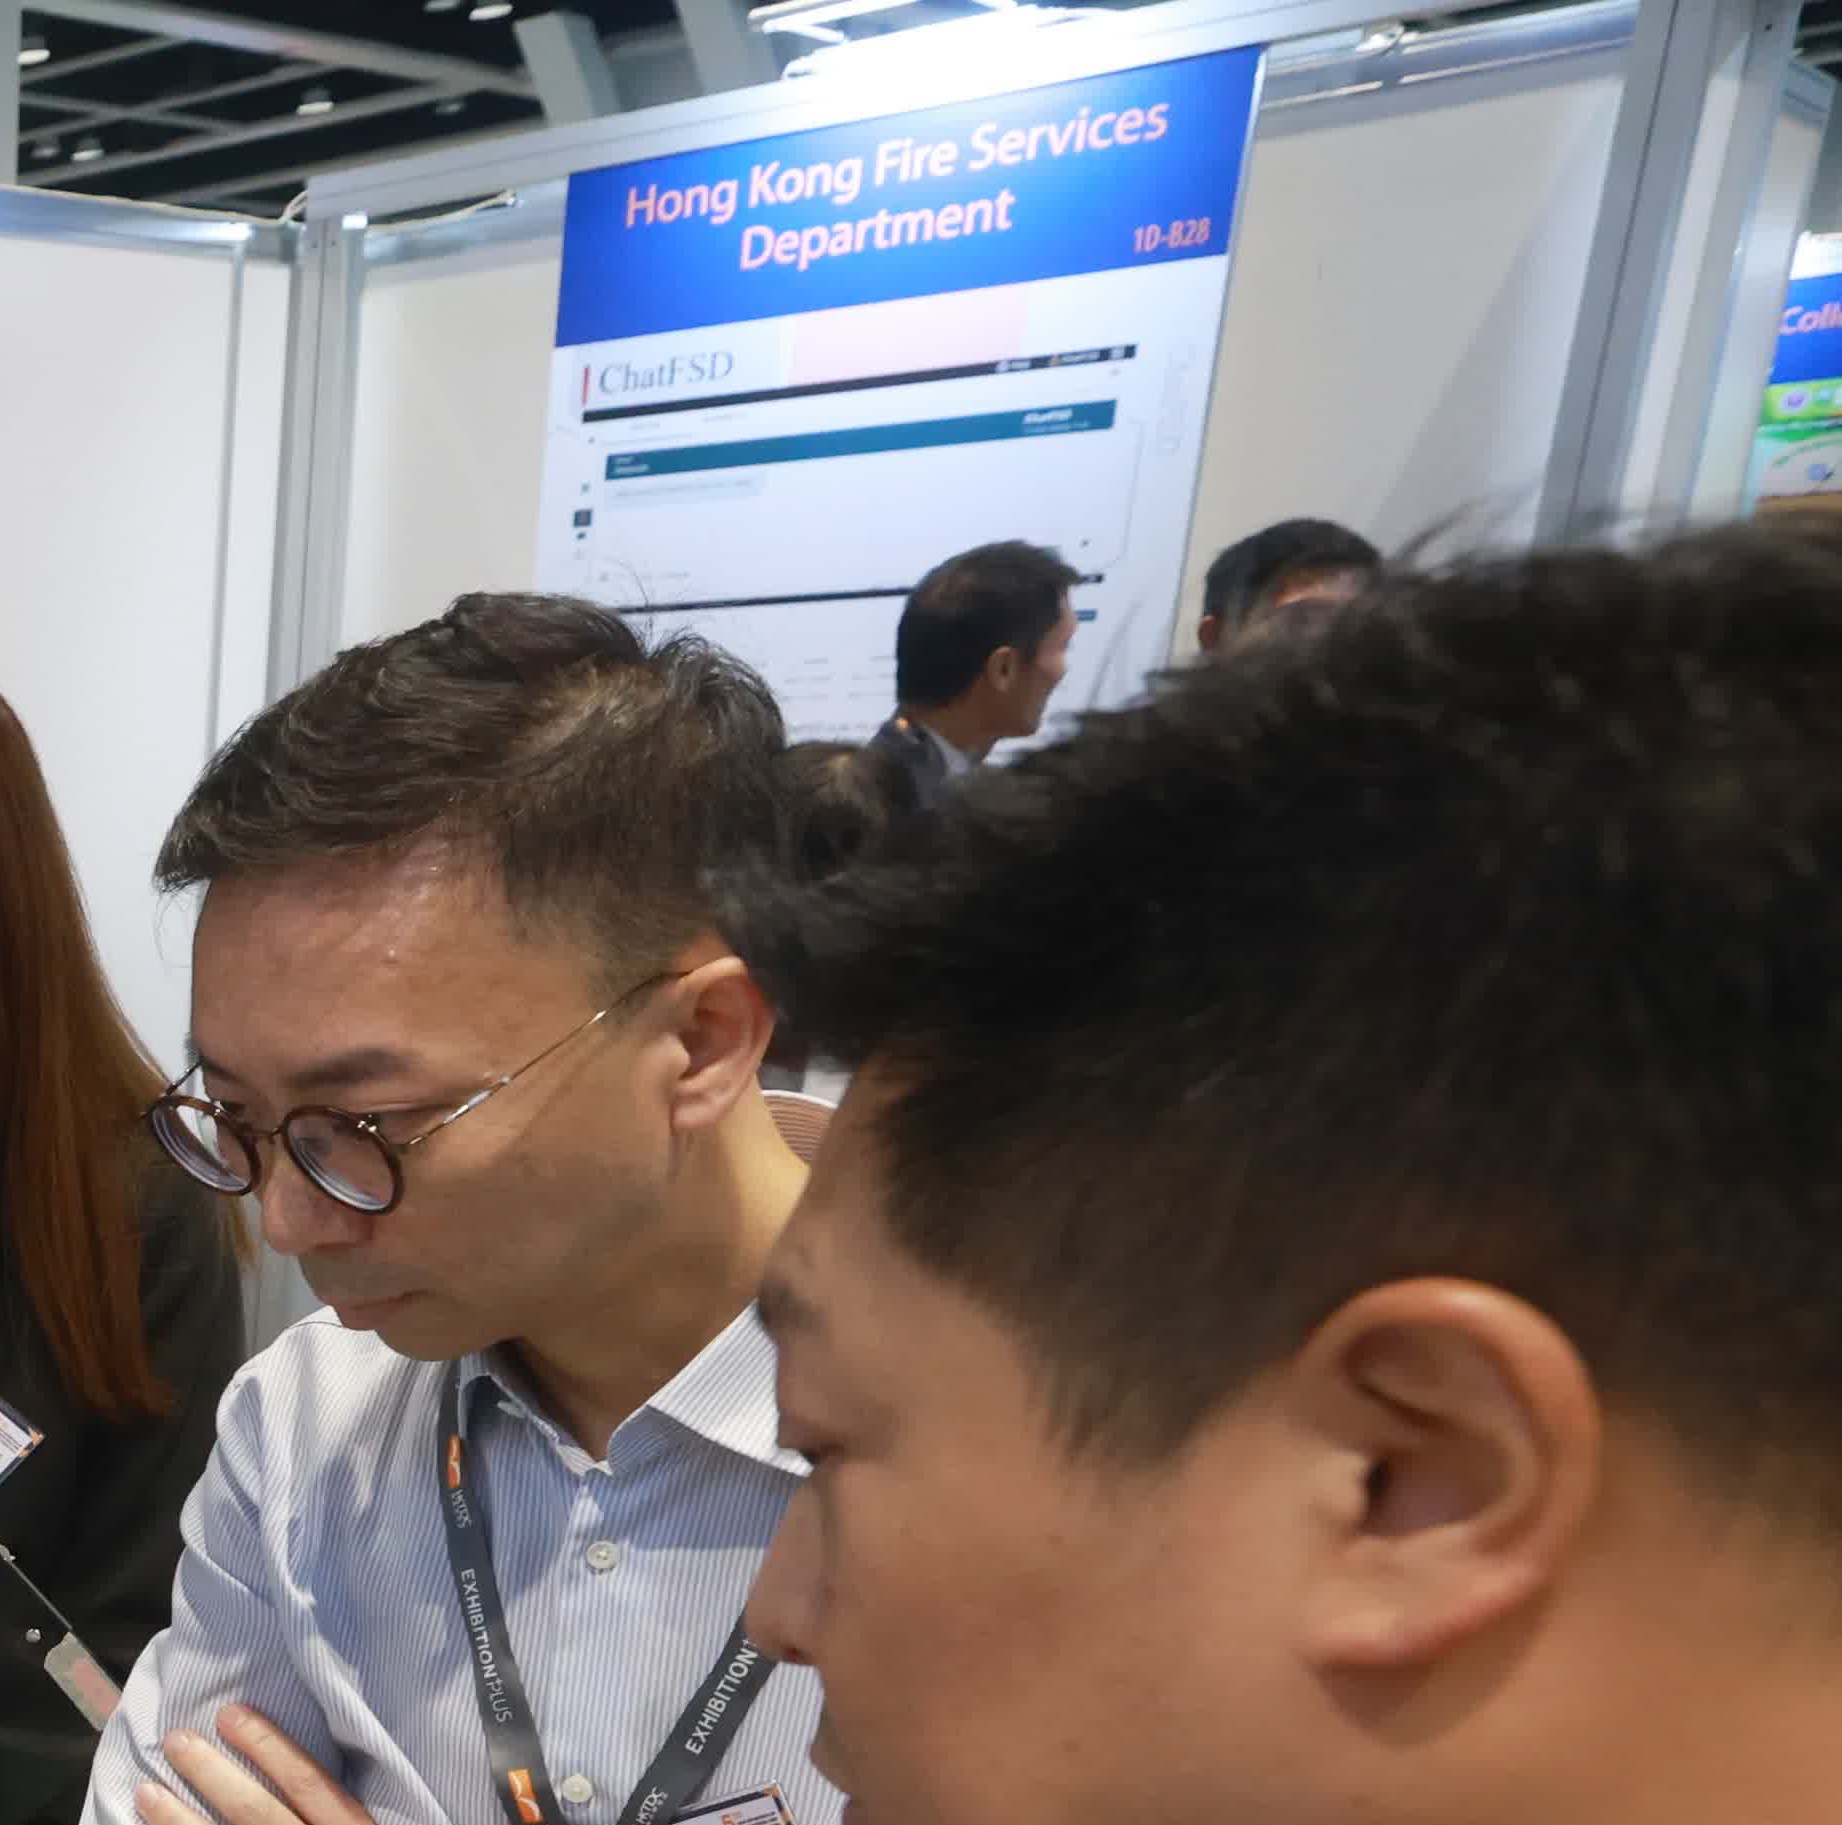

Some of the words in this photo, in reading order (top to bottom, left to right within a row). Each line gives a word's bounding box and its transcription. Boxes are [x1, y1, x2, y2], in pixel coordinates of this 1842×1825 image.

[624, 182, 738, 229] Hong
[748, 158, 862, 208] Kong
[874, 137, 958, 188] Fire
[969, 100, 1170, 169] Services
[739, 188, 1016, 272] Department
[1132, 218, 1212, 254] 1D-B28
[597, 350, 736, 397] ChatFSD
